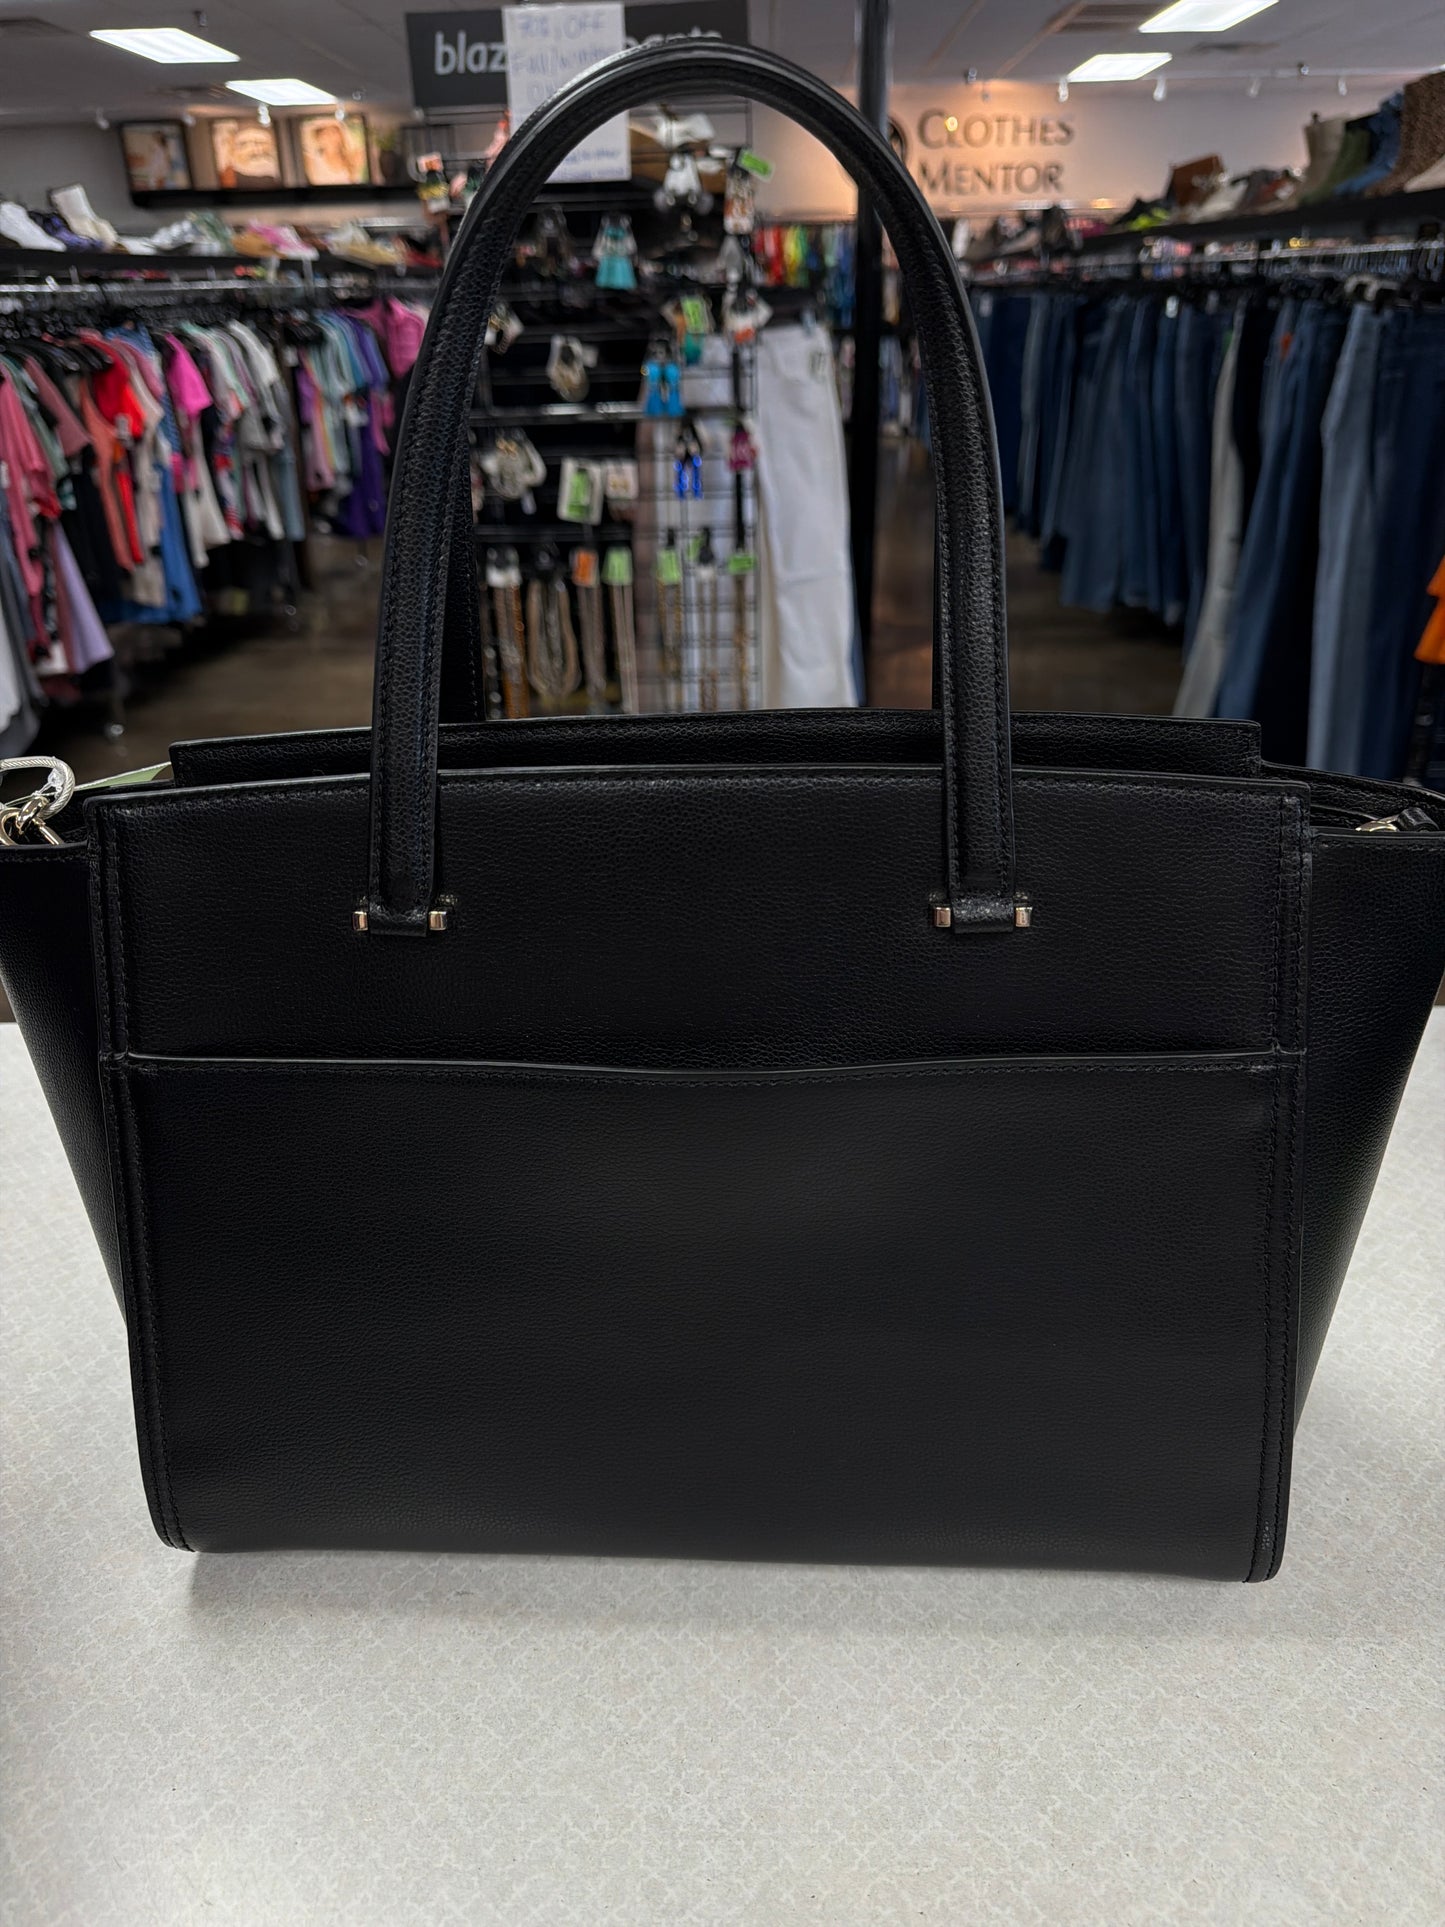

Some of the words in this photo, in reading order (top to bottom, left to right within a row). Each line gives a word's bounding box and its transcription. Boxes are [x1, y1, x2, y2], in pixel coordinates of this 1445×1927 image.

[434, 29, 507, 76] blaz
[917, 109, 1075, 149] CLOTHES
[919, 157, 1064, 195] MENTOR
